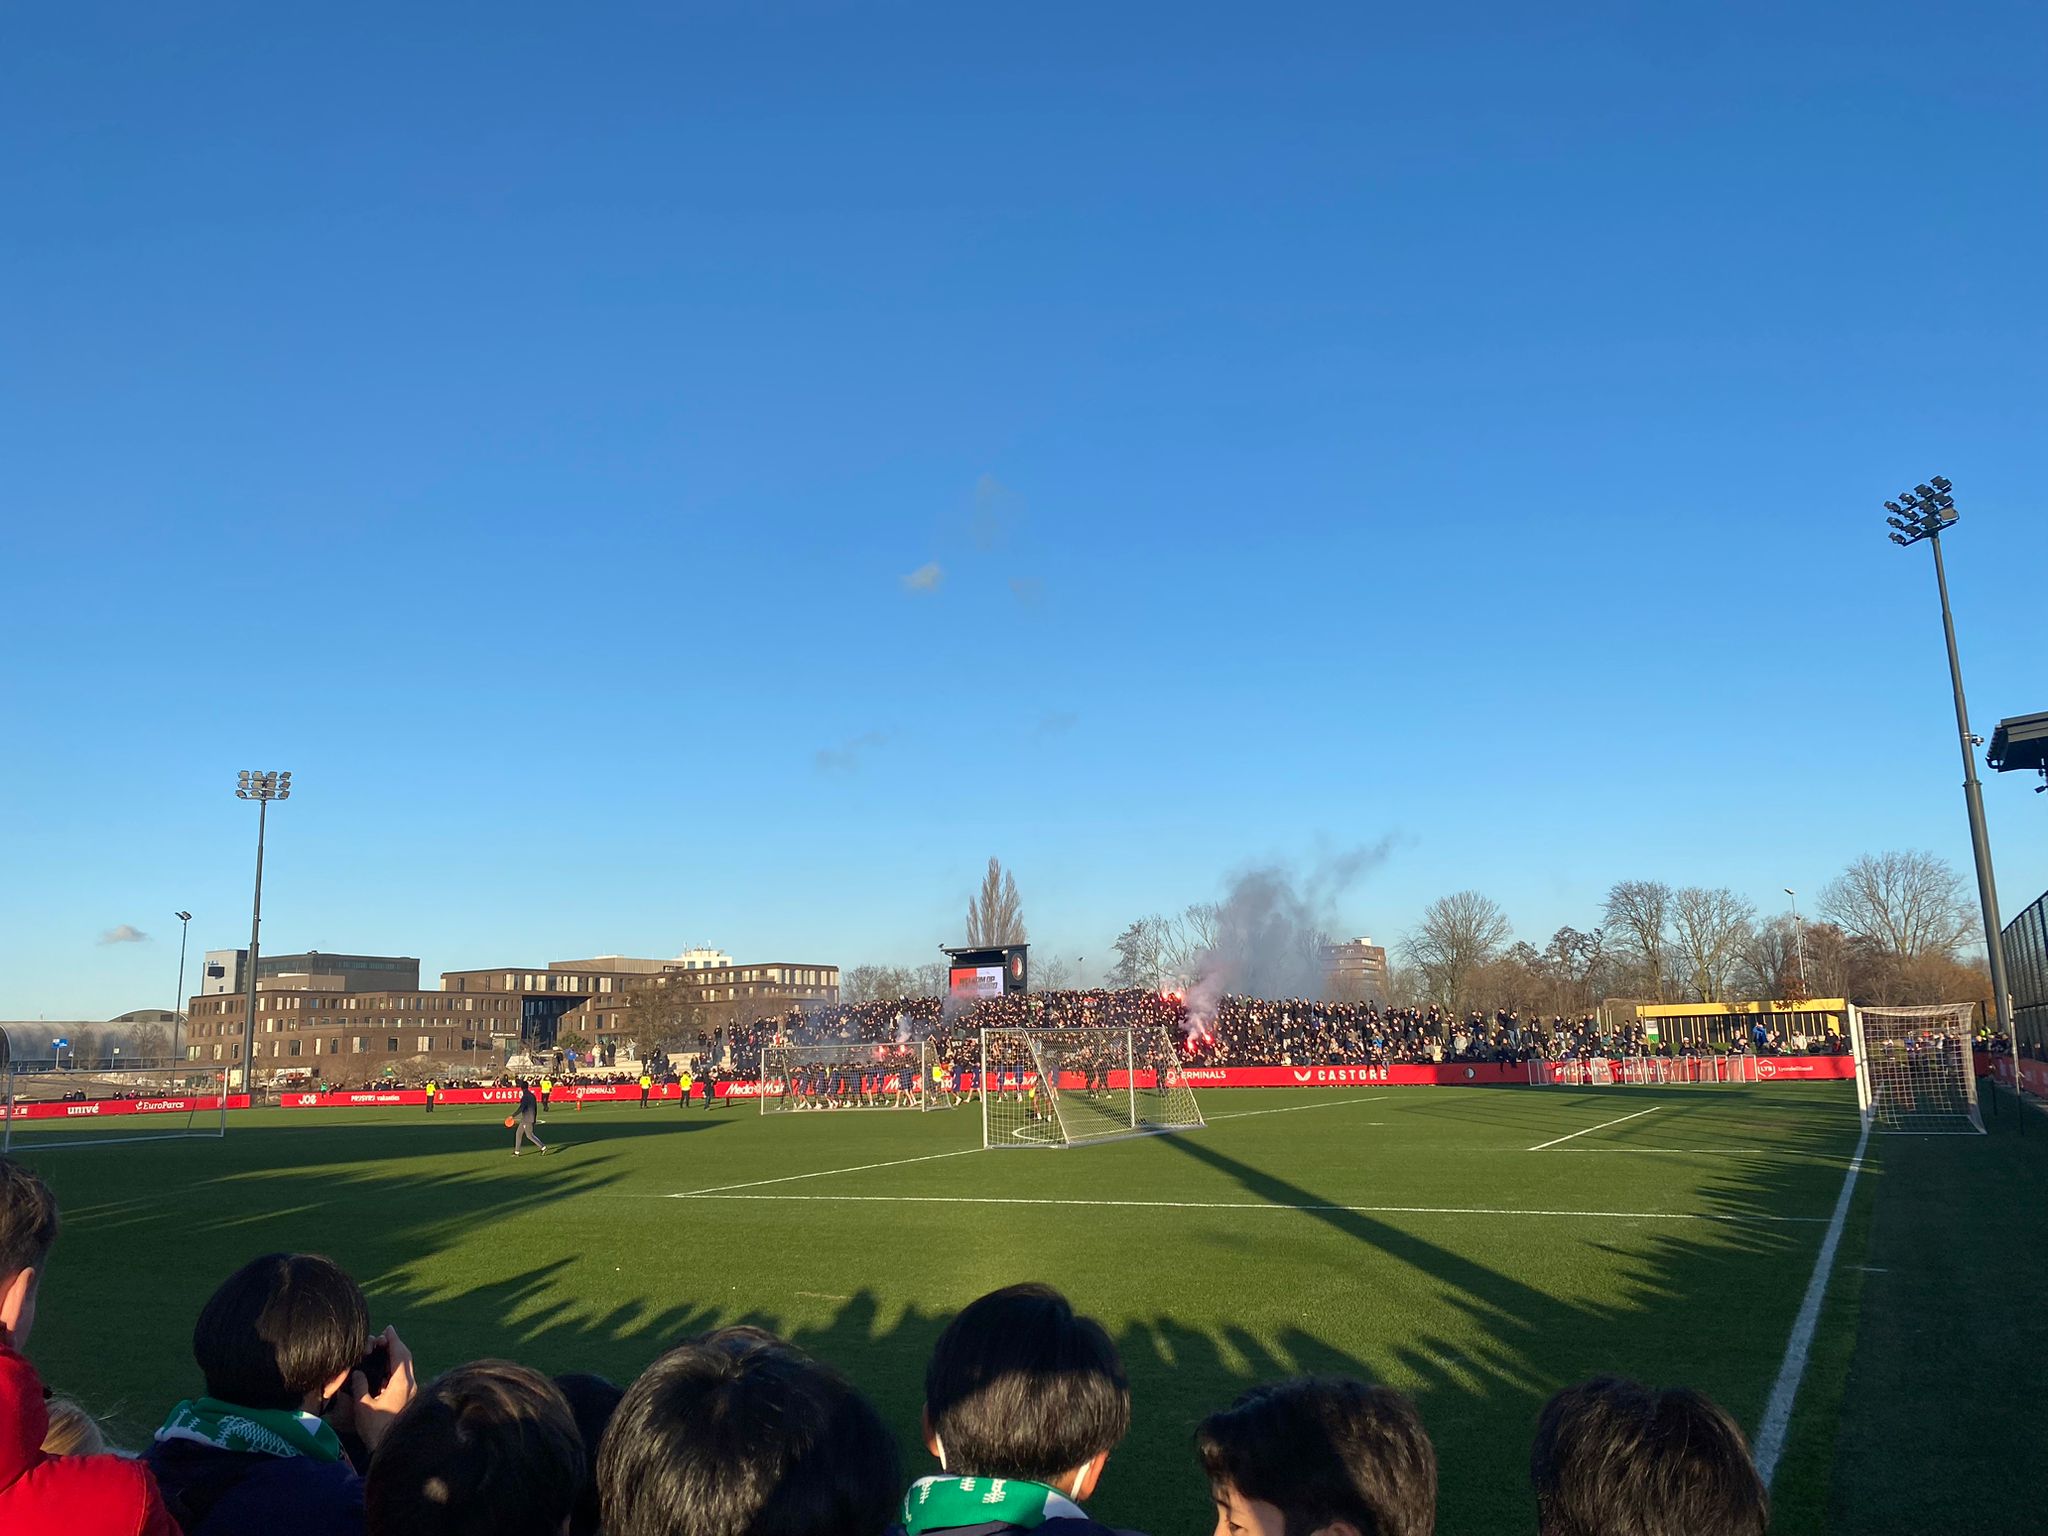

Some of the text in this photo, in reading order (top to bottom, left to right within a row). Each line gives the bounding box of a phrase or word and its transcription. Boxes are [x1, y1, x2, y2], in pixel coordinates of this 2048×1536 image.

[1318, 1069, 1387, 1081] CASTORE
[67, 1103, 99, 1114] univé
[143, 1101, 184, 1110] EuroParcs
